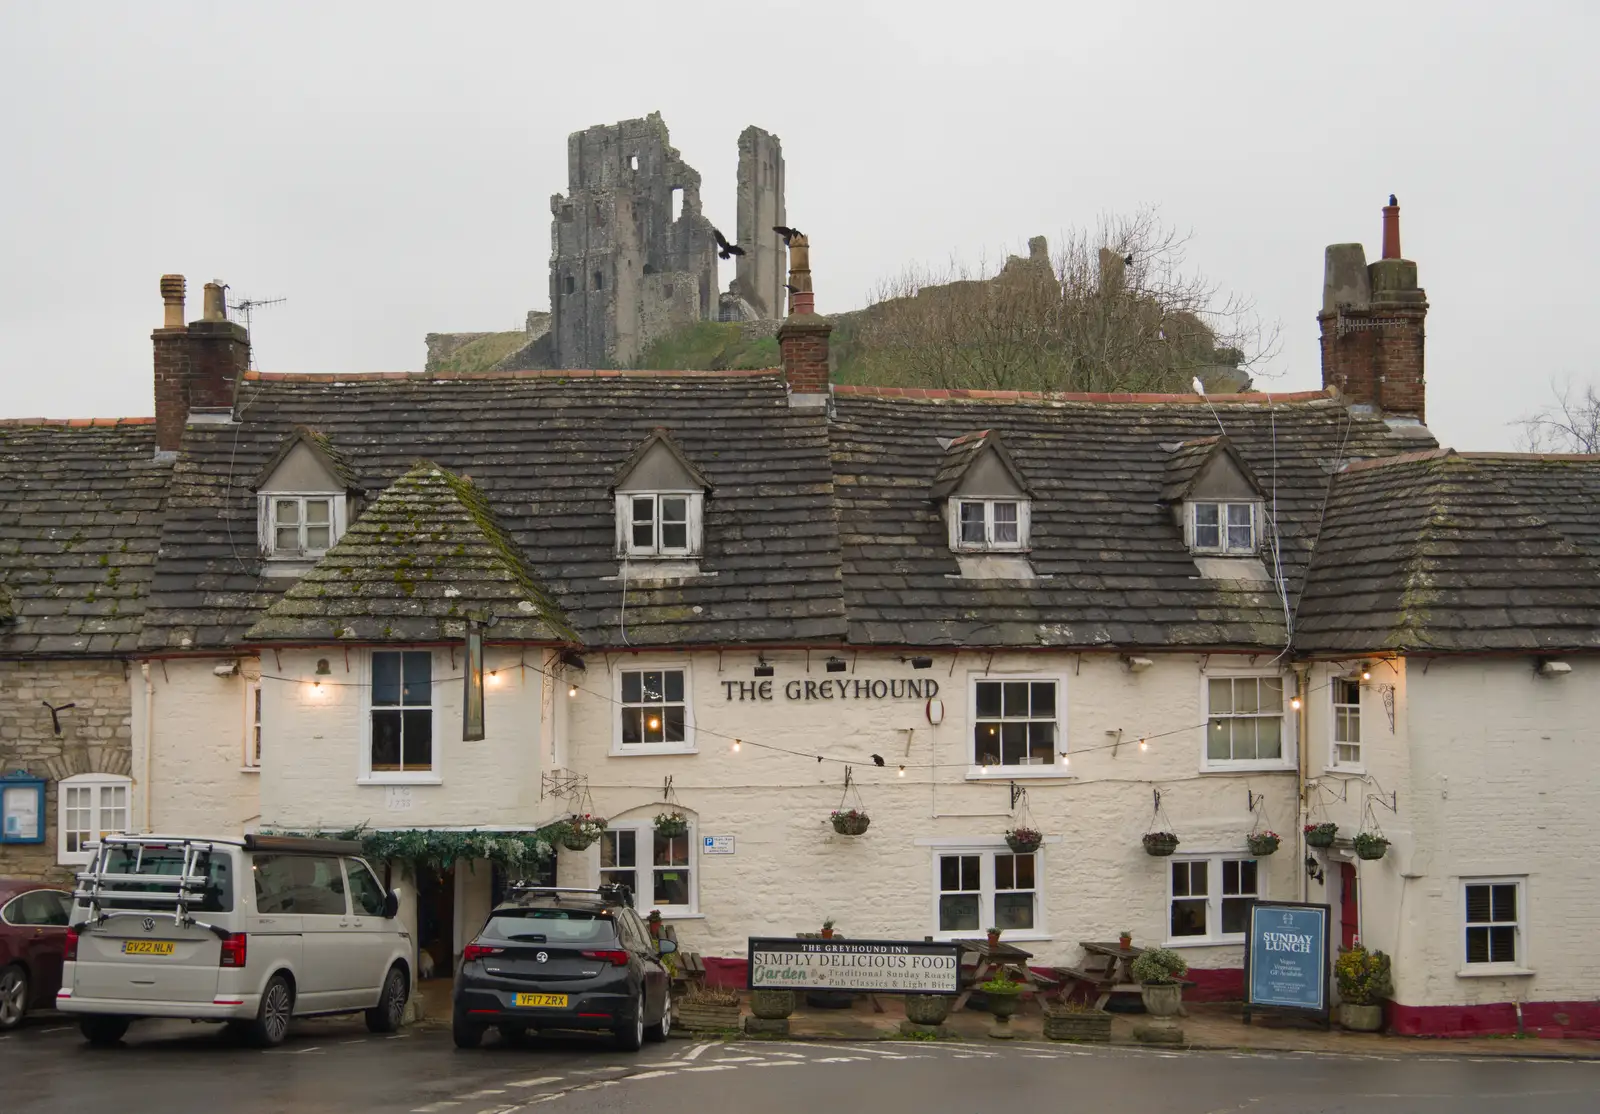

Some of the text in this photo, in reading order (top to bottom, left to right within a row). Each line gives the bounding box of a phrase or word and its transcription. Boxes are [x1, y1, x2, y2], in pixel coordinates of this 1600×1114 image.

[721, 678, 939, 701] THE GREYHOUND
[1263, 931, 1313, 944] SUNDAY
[126, 941, 173, 953] GV22 NLN
[801, 944, 909, 954] THE GREYHOUND INN
[1265, 941, 1310, 953] LUNCH
[754, 953, 956, 970] SIMPLY DELICIOUS FOOD
[754, 965, 807, 983] Garden
[828, 969, 955, 980] Traditional Sunday Roasts
[828, 978, 847, 986] Pub
[849, 979, 887, 988] Classics
[902, 981, 926, 989] Light
[932, 982, 956, 990] Bites
[520, 995, 565, 1006] YF17 ZRX
